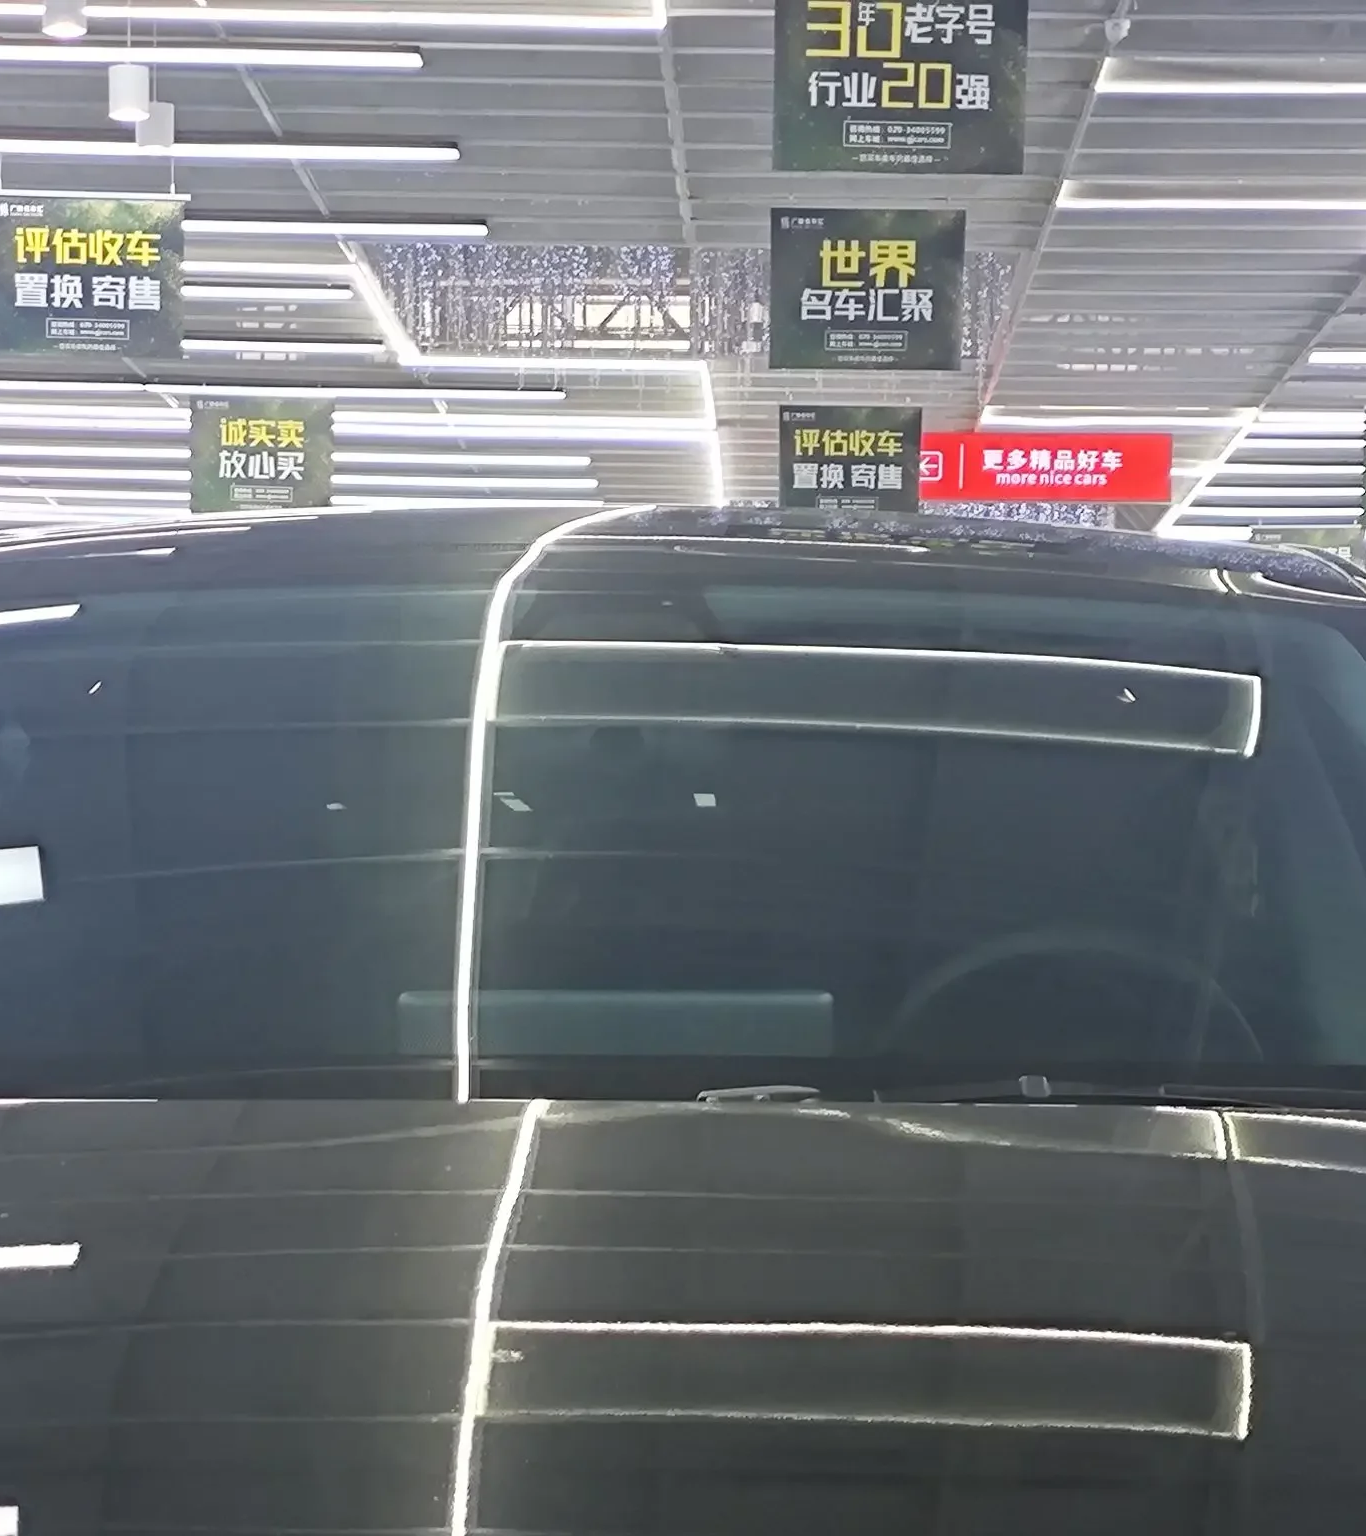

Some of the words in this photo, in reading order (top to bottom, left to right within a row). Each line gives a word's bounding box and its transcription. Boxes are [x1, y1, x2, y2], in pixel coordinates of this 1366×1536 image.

[806, 0, 995, 58] 30年老字号
[808, 62, 990, 110] 行业20强
[14, 225, 162, 267] 评估收车
[819, 239, 917, 289] 世界
[14, 272, 83, 309] 置换
[91, 275, 162, 311] 寄售
[800, 288, 934, 322] 名车汇聚
[219, 417, 305, 448] 诚实卖
[793, 428, 904, 458] 评估收车
[218, 450, 305, 480] 放心买
[792, 462, 844, 490] 置换
[850, 463, 903, 490] 寄售
[982, 449, 1124, 472] 更多精品好车
[995, 473, 1037, 486] more
[1039, 470, 1072, 486] nice
[1074, 472, 1108, 486] cars
